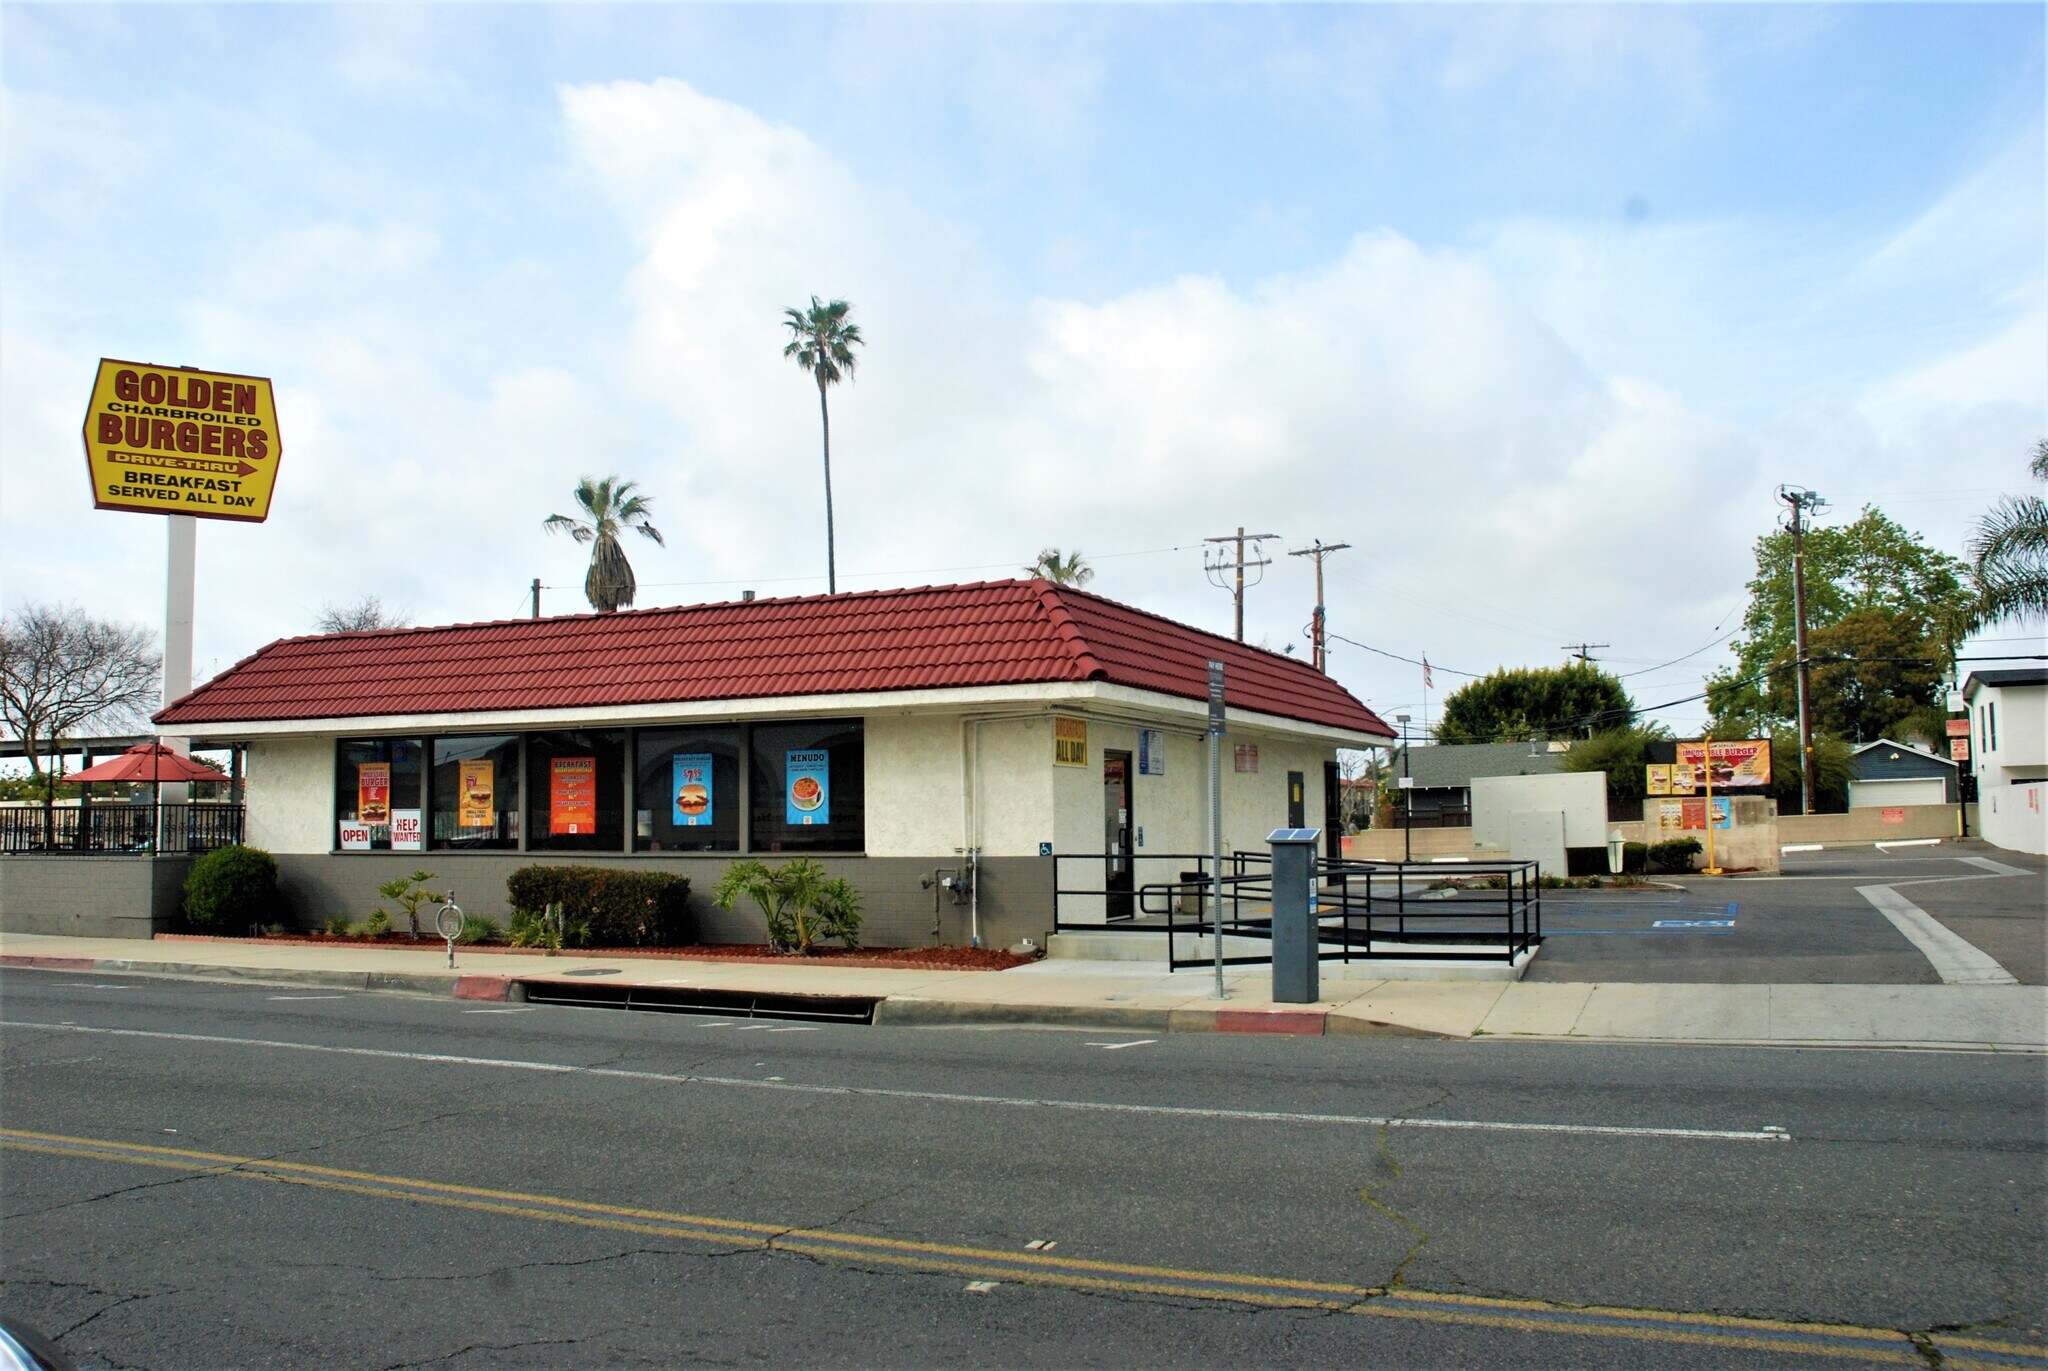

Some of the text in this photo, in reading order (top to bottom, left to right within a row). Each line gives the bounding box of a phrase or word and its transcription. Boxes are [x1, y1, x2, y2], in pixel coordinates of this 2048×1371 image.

[115, 370, 256, 415] GOLDEN
[107, 402, 261, 427] CHARBROILED
[98, 412, 268, 460] BURGERS
[115, 453, 238, 473] DRIVE-THRU
[124, 471, 242, 493] BREAKFAST
[108, 485, 256, 507] SERVED ALL DAY
[790, 754, 825, 762] MENUDO
[1056, 740, 1084, 763] ALL DAY
[1682, 747, 1758, 757] IMPOSBLE BURGER
[361, 778, 389, 786] BURGER
[396, 819, 418, 831] HELP
[343, 829, 368, 842] OPEN
[393, 832, 421, 842] WANTED
